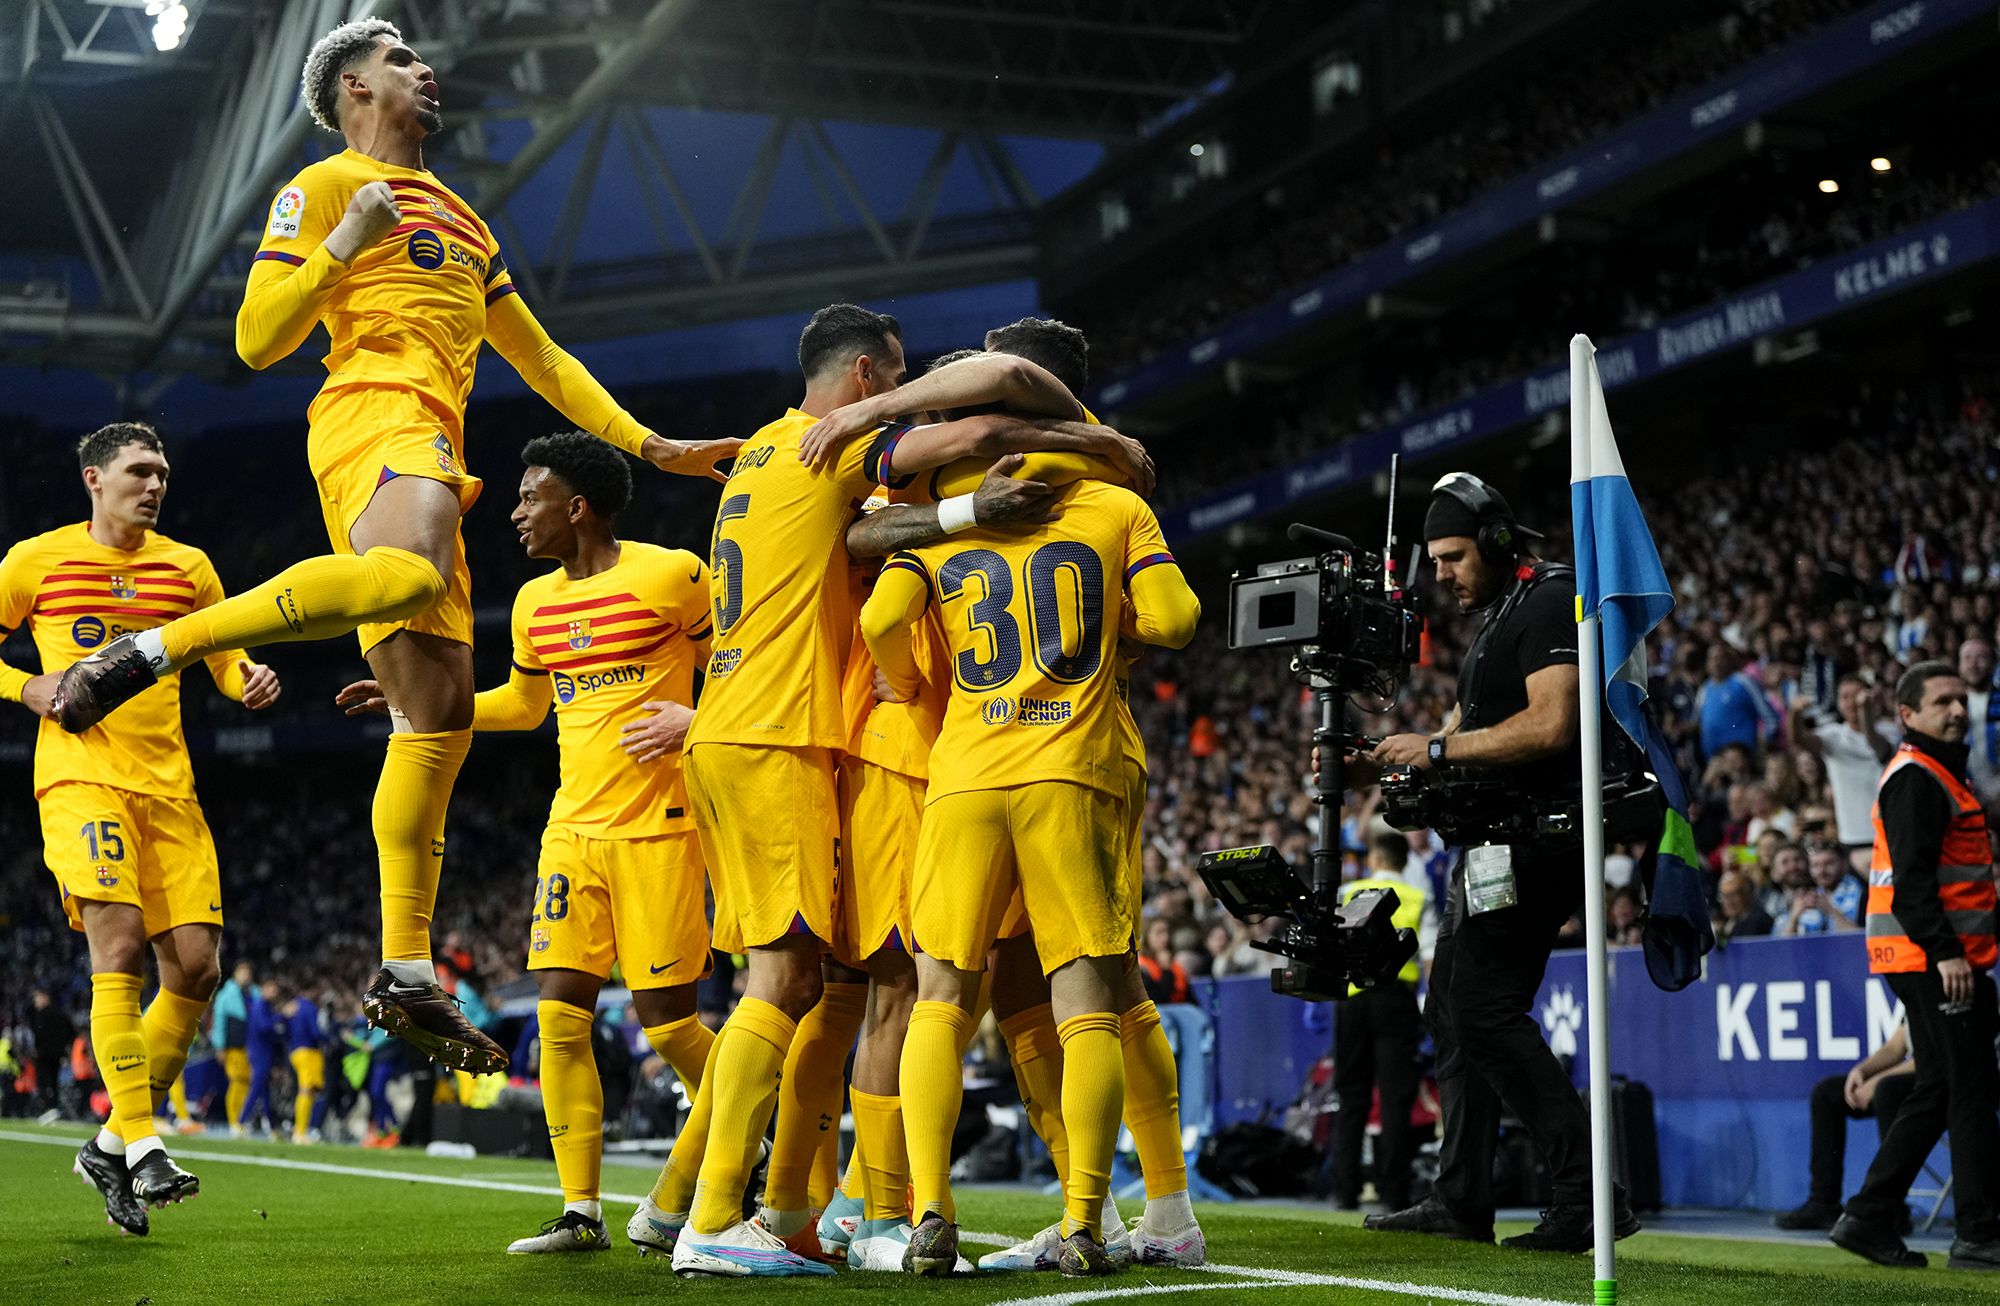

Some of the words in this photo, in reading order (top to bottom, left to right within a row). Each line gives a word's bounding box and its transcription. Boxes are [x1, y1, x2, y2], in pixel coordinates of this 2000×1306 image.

[272, 221, 296, 231] LaLiga
[1834, 240, 1927, 300] KELME
[712, 494, 751, 636] 5
[936, 541, 1104, 693] 30
[577, 664, 646, 692] Spotify
[1018, 710, 1071, 721] ACNUR
[1019, 697, 1071, 711] UNHCR
[79, 821, 125, 862] 15
[532, 873, 569, 922] 28
[1716, 978, 1905, 1061] KELM
[112, 1054, 146, 1062] barça
